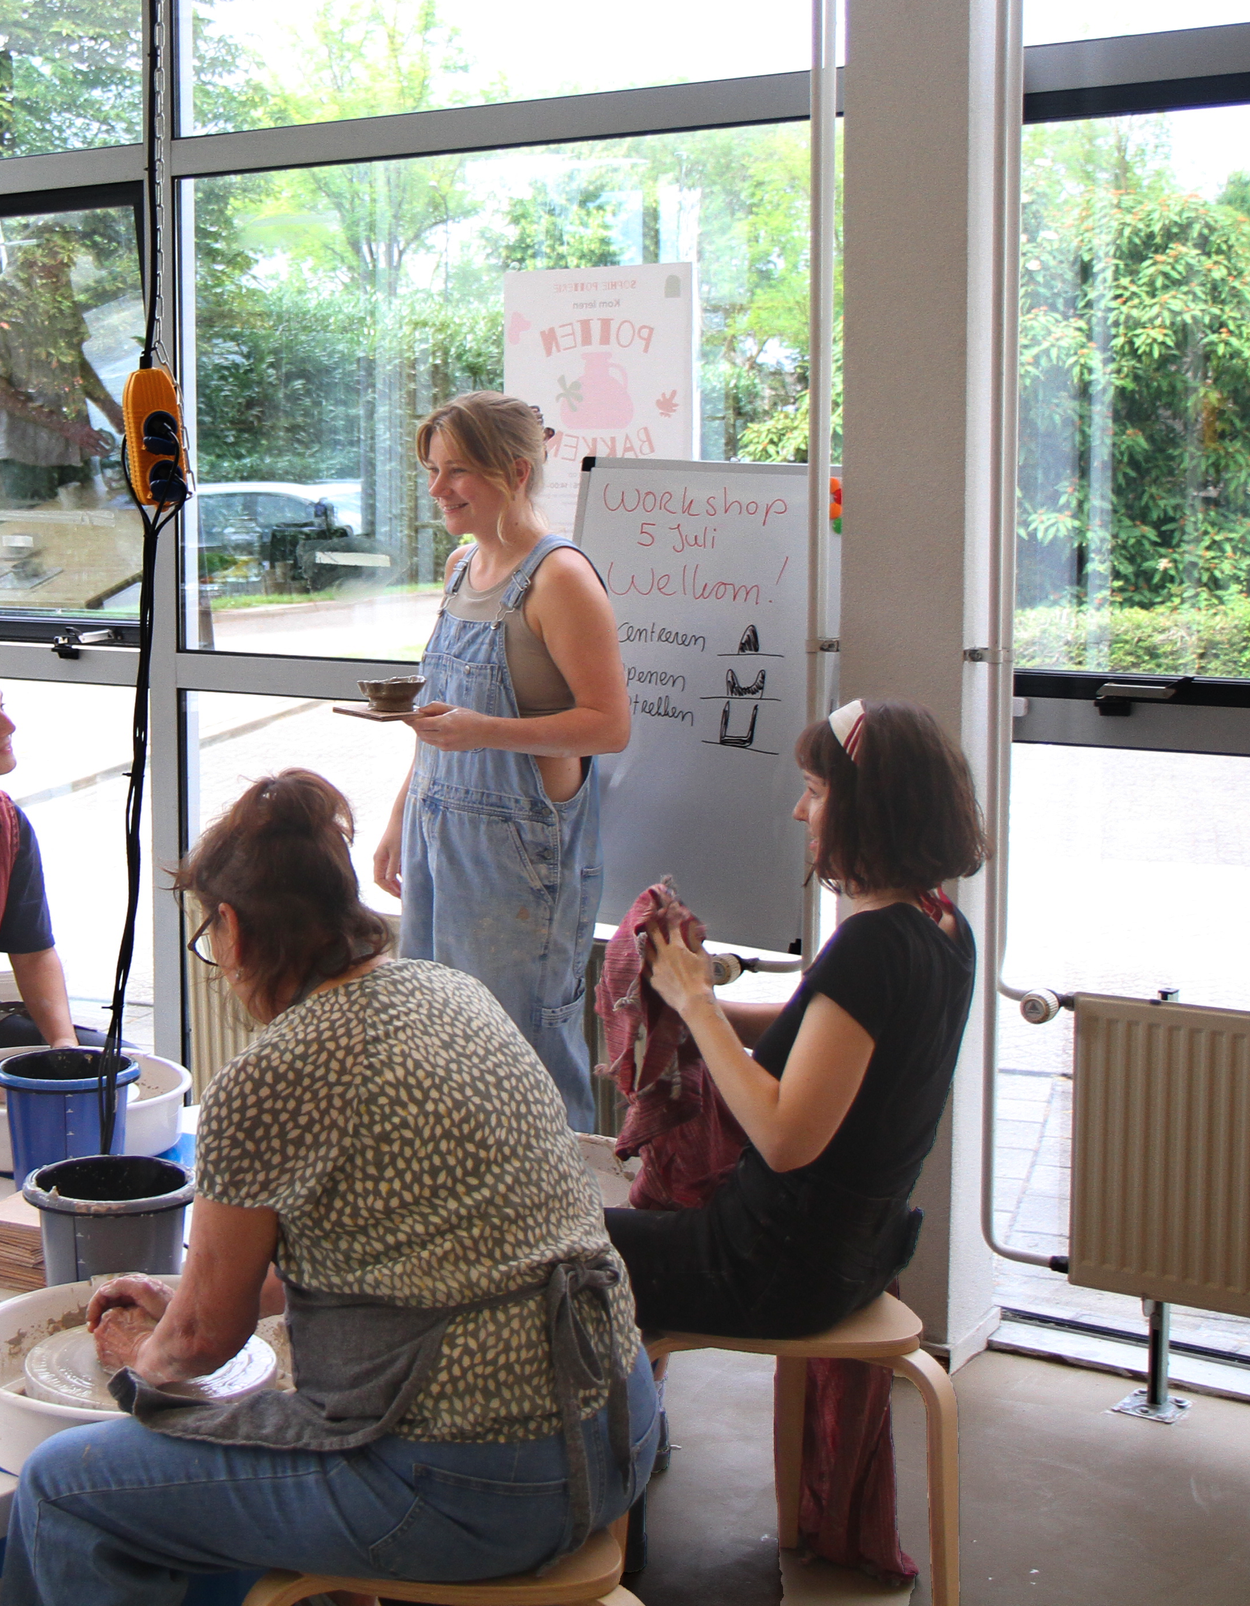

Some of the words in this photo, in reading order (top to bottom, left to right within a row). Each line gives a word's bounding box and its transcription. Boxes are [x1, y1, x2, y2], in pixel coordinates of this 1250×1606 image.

[637, 522, 656, 547] 5
[669, 523, 717, 553] Juli
[623, 663, 686, 692] penen
